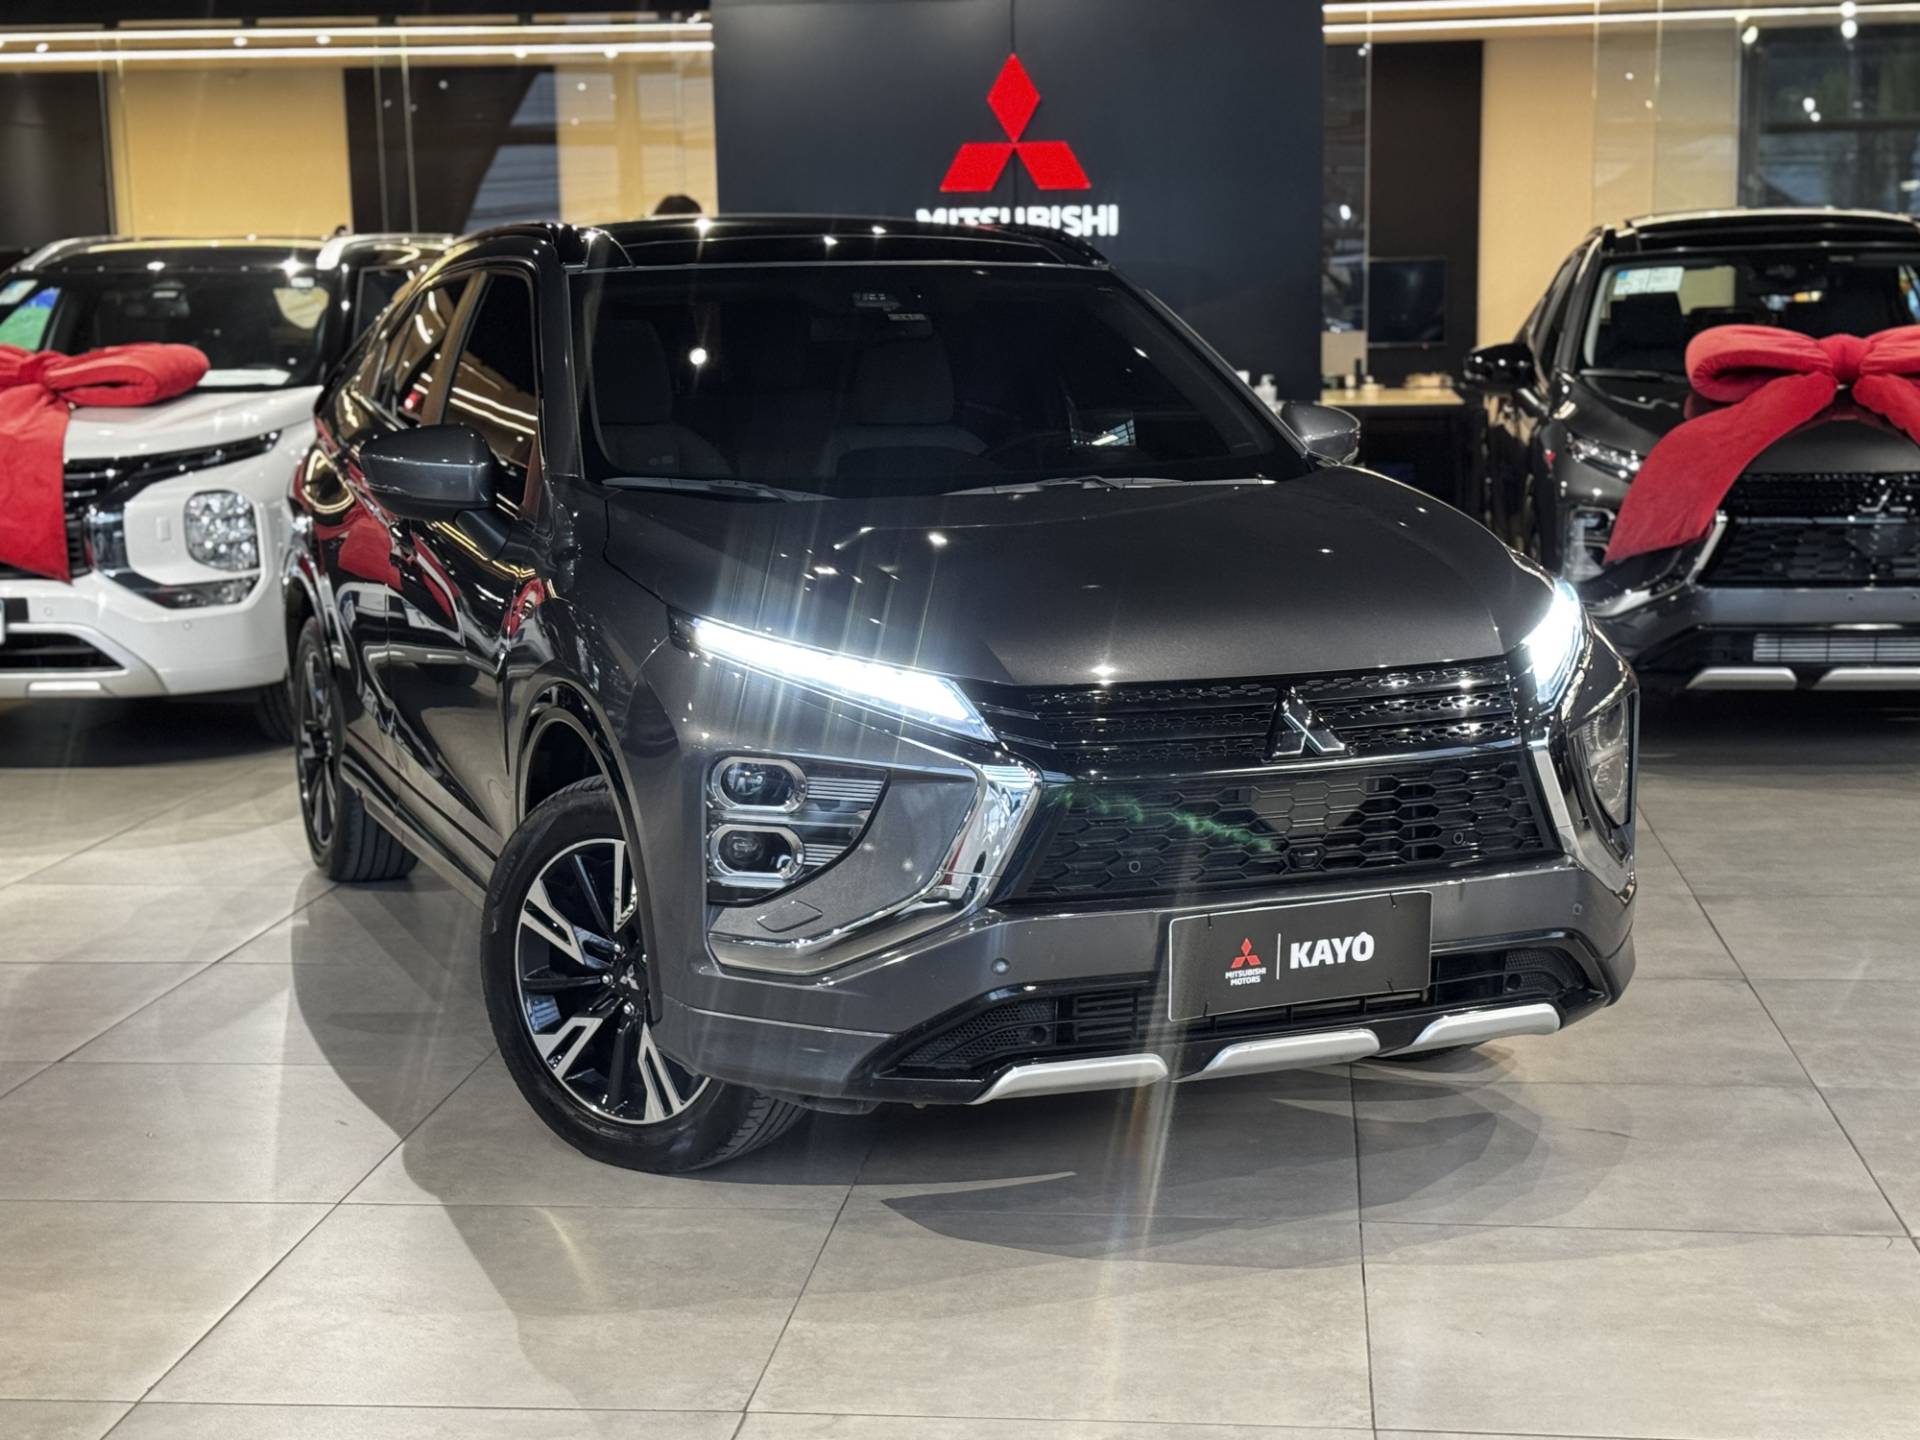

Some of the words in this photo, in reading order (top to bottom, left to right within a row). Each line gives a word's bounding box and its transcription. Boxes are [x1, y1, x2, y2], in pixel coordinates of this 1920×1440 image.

[1289, 931, 1375, 969] KAYÔ
[1225, 967, 1267, 979] MITSUBISHI
[1230, 975, 1261, 986] MOTORS
